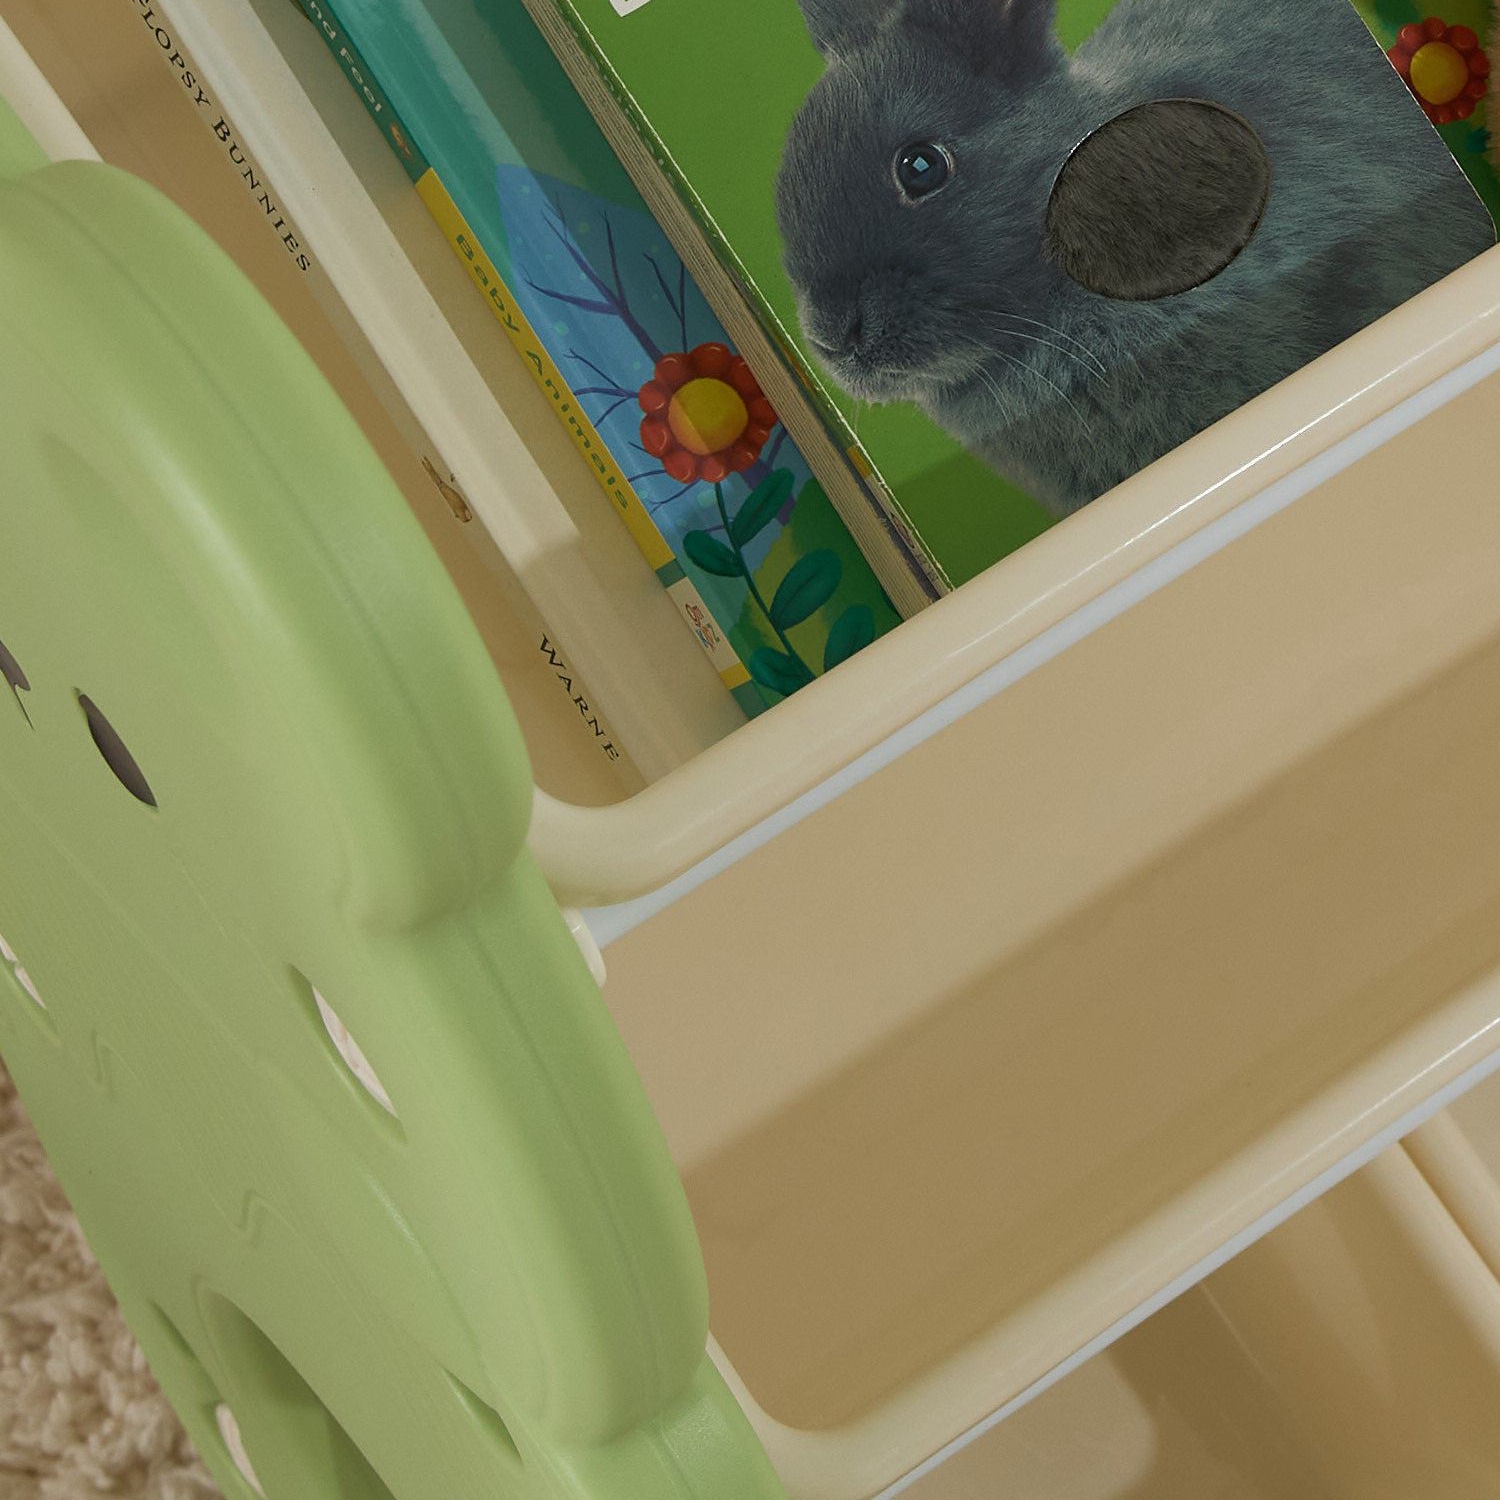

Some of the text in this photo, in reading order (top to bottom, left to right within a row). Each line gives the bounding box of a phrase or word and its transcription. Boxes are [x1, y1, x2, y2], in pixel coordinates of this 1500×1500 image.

[339, 46, 383, 113] Feel
[210, 115, 312, 273] BUNNIES
[455, 233, 629, 510] Baby Animals
[538, 633, 621, 762] WARNE
